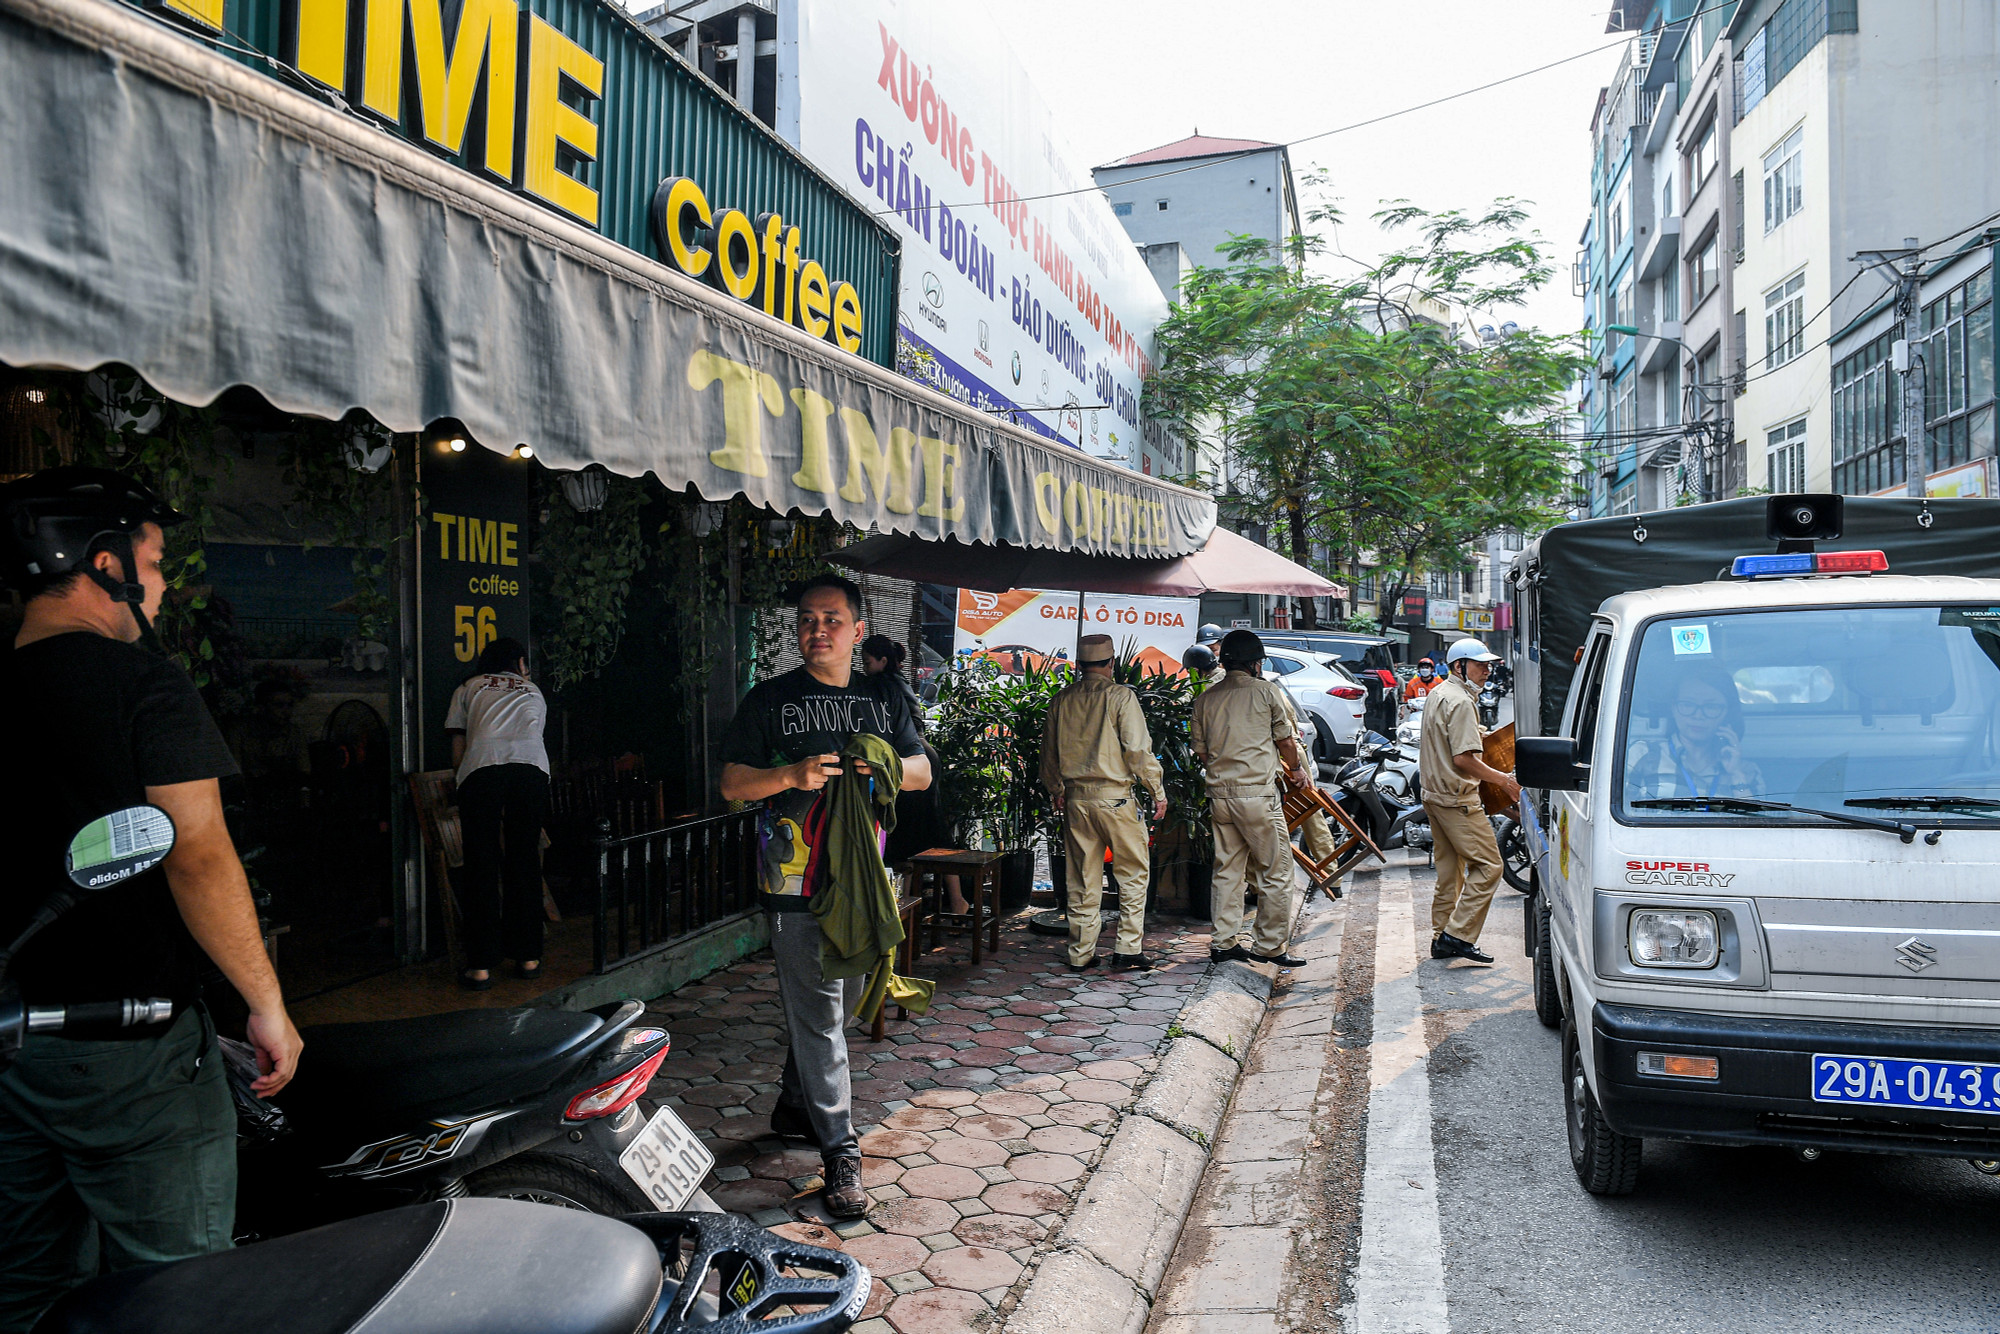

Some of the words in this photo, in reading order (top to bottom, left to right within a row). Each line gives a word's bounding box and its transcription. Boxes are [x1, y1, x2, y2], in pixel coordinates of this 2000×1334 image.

[877, 19, 975, 187] XƯỞNG
[981, 150, 1028, 252] THỰC
[1034, 216, 1073, 302] HÀNH
[1077, 271, 1100, 332] ĐÀO
[1104, 303, 1121, 357] TẠO
[654, 176, 863, 354] coffee
[855, 117, 931, 244] CHẨN
[939, 199, 994, 302] ĐOÁN
[1012, 274, 1041, 344] BẢO
[1046, 310, 1086, 385] DƯỠNG
[1096, 357, 1114, 411] SỬA
[1116, 382, 1138, 432] CHỮA
[918, 301, 948, 334] HYUNDAI
[974, 347, 993, 369] HONDA
[688, 349, 965, 523] TIME
[1035, 471, 1169, 547] COFFEE
[433, 512, 518, 567] TIME
[468, 574, 519, 596] coffee
[454, 605, 498, 663] 56
[1040, 604, 1089, 622] GARA
[1095, 604, 1110, 623] Ô
[1115, 606, 1138, 625] TÔ
[1144, 611, 1185, 628] DISA
[781, 699, 864, 735] AMONG
[1625, 871, 1736, 888] CARRY
[1626, 860, 1710, 872] SUPER
[652, 1139, 709, 1210] 919.01
